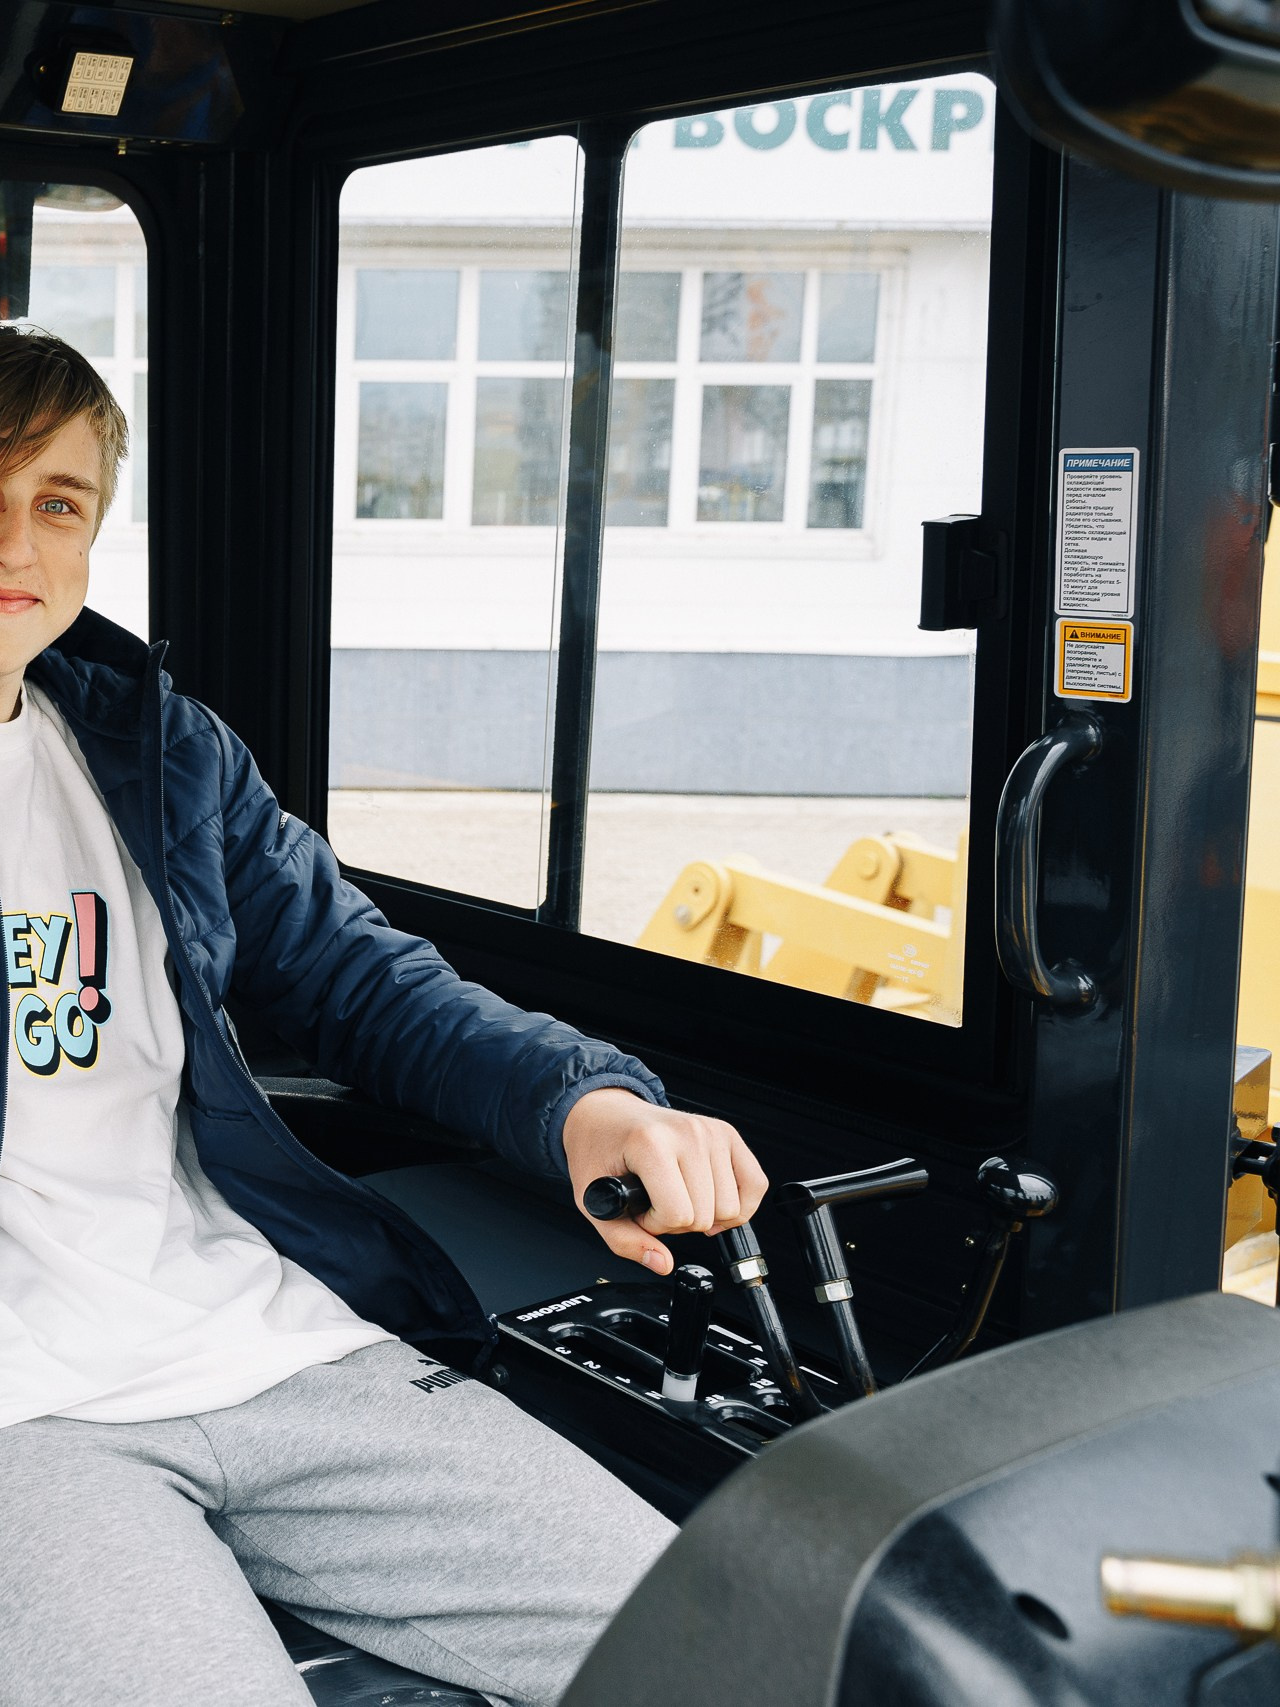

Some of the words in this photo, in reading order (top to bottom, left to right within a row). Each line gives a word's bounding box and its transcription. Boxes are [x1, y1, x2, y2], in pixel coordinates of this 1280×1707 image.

[674, 88, 996, 152] ВОСКР
[1066, 459, 1132, 467] ПРИМЕЧАНИЕ
[1081, 632, 1121, 640] ВНИМАНИЕ
[516, 1294, 593, 1322] LIUGONG
[554, 1346, 572, 1355] 3
[582, 1360, 601, 1370] 2
[614, 1375, 631, 1384] 1
[644, 1390, 666, 1400] N
